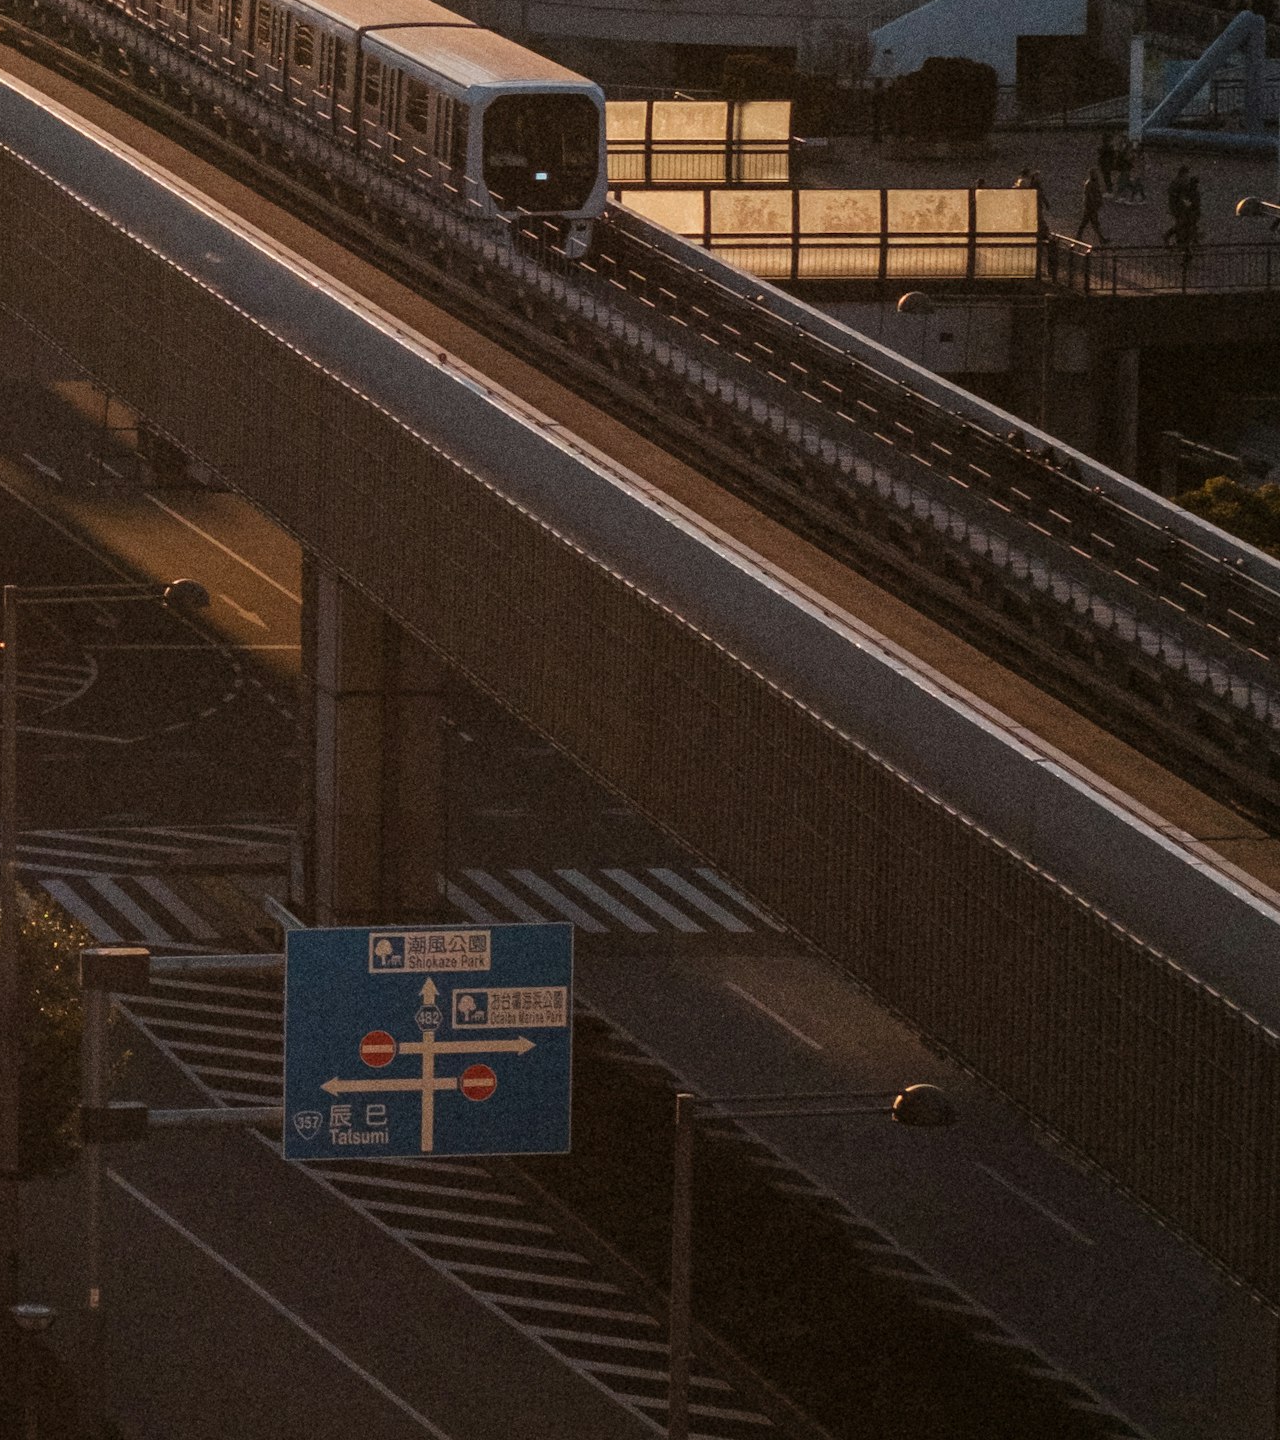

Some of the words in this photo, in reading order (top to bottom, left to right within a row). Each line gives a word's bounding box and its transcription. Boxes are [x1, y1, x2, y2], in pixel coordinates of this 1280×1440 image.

[407, 935, 487, 954] 潮風公園
[408, 954, 458, 969] Shiokaze
[461, 954, 486, 968] Park
[491, 990, 563, 1010] お台場海浜公園
[418, 1011, 439, 1025] 482
[297, 1116, 319, 1130] 357
[330, 1128, 389, 1146] Tatsumi
